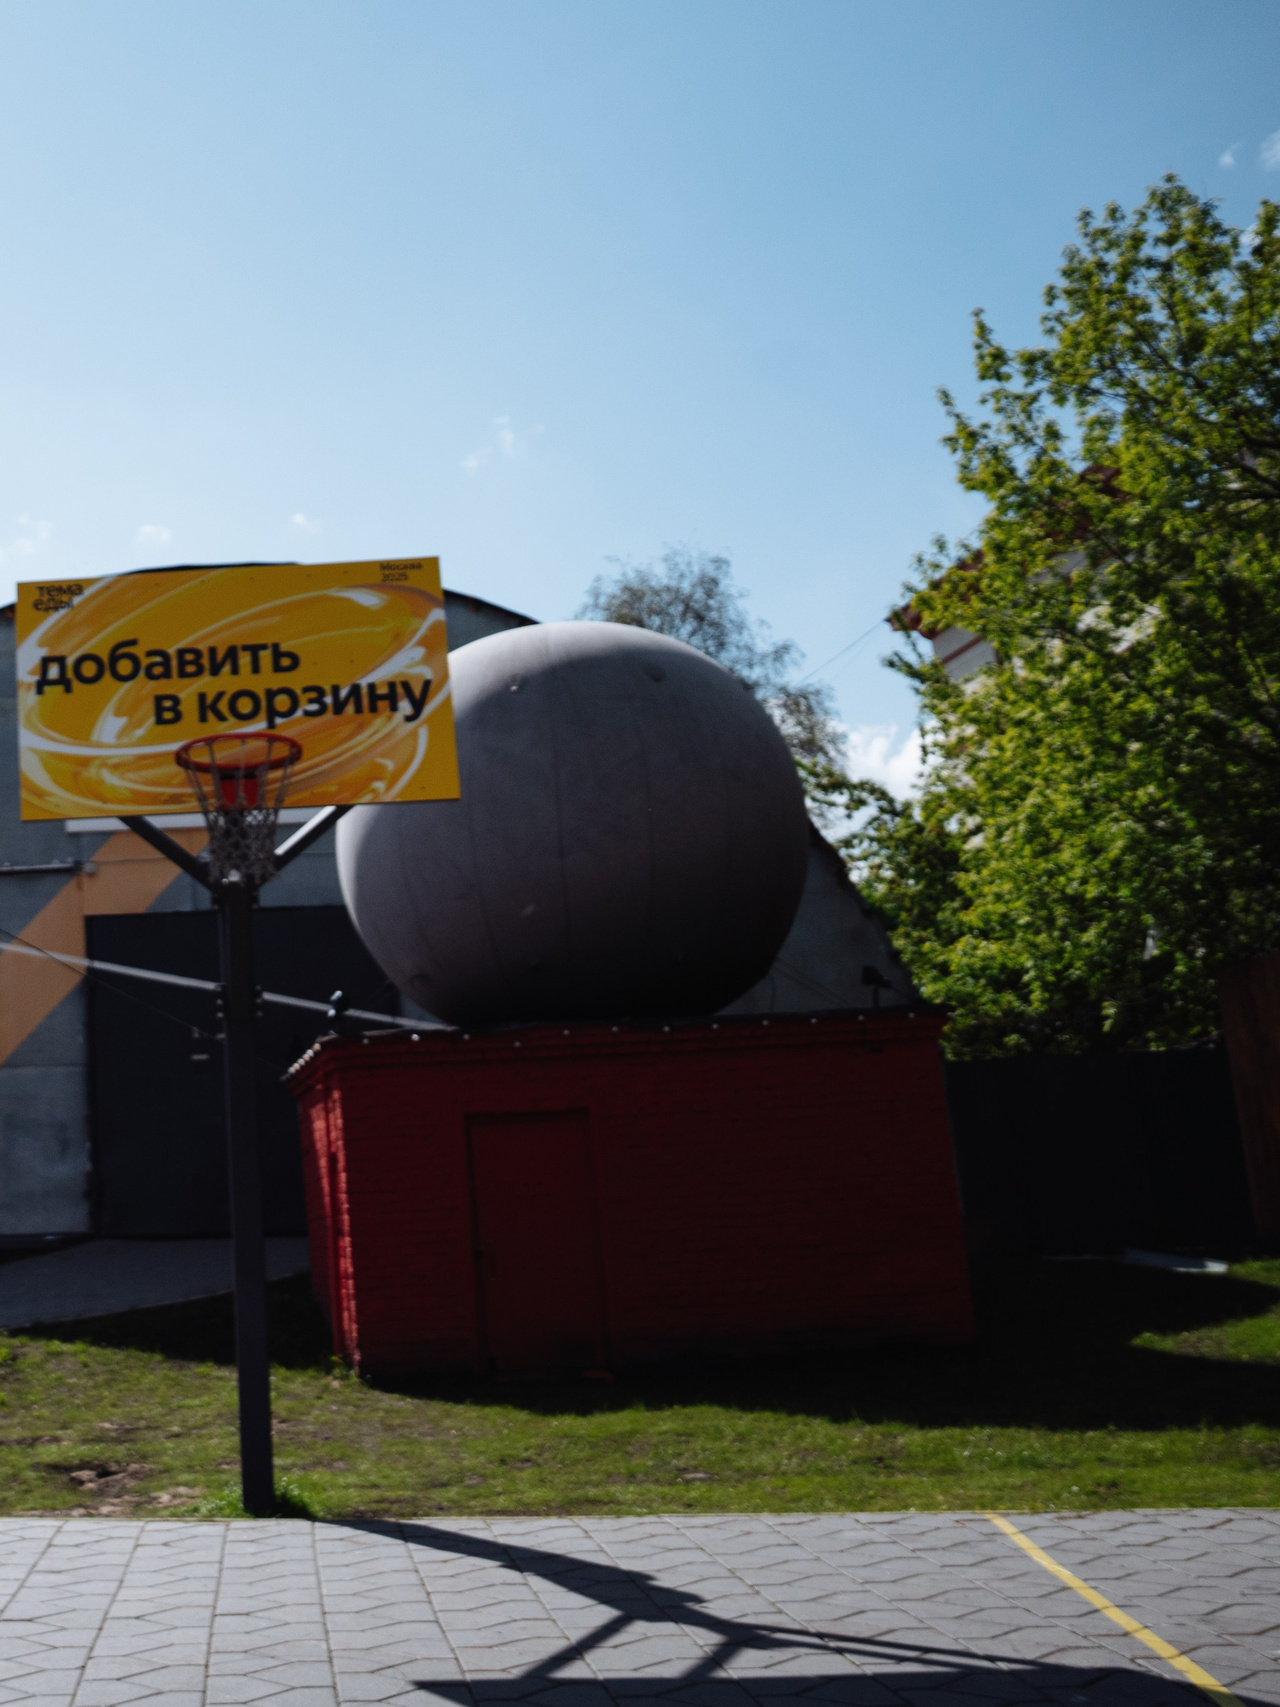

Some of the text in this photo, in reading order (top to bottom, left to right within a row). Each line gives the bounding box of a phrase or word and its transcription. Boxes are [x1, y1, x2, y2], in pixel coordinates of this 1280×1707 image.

[36, 638, 300, 695] добавить
[154, 678, 432, 729] в корзину
